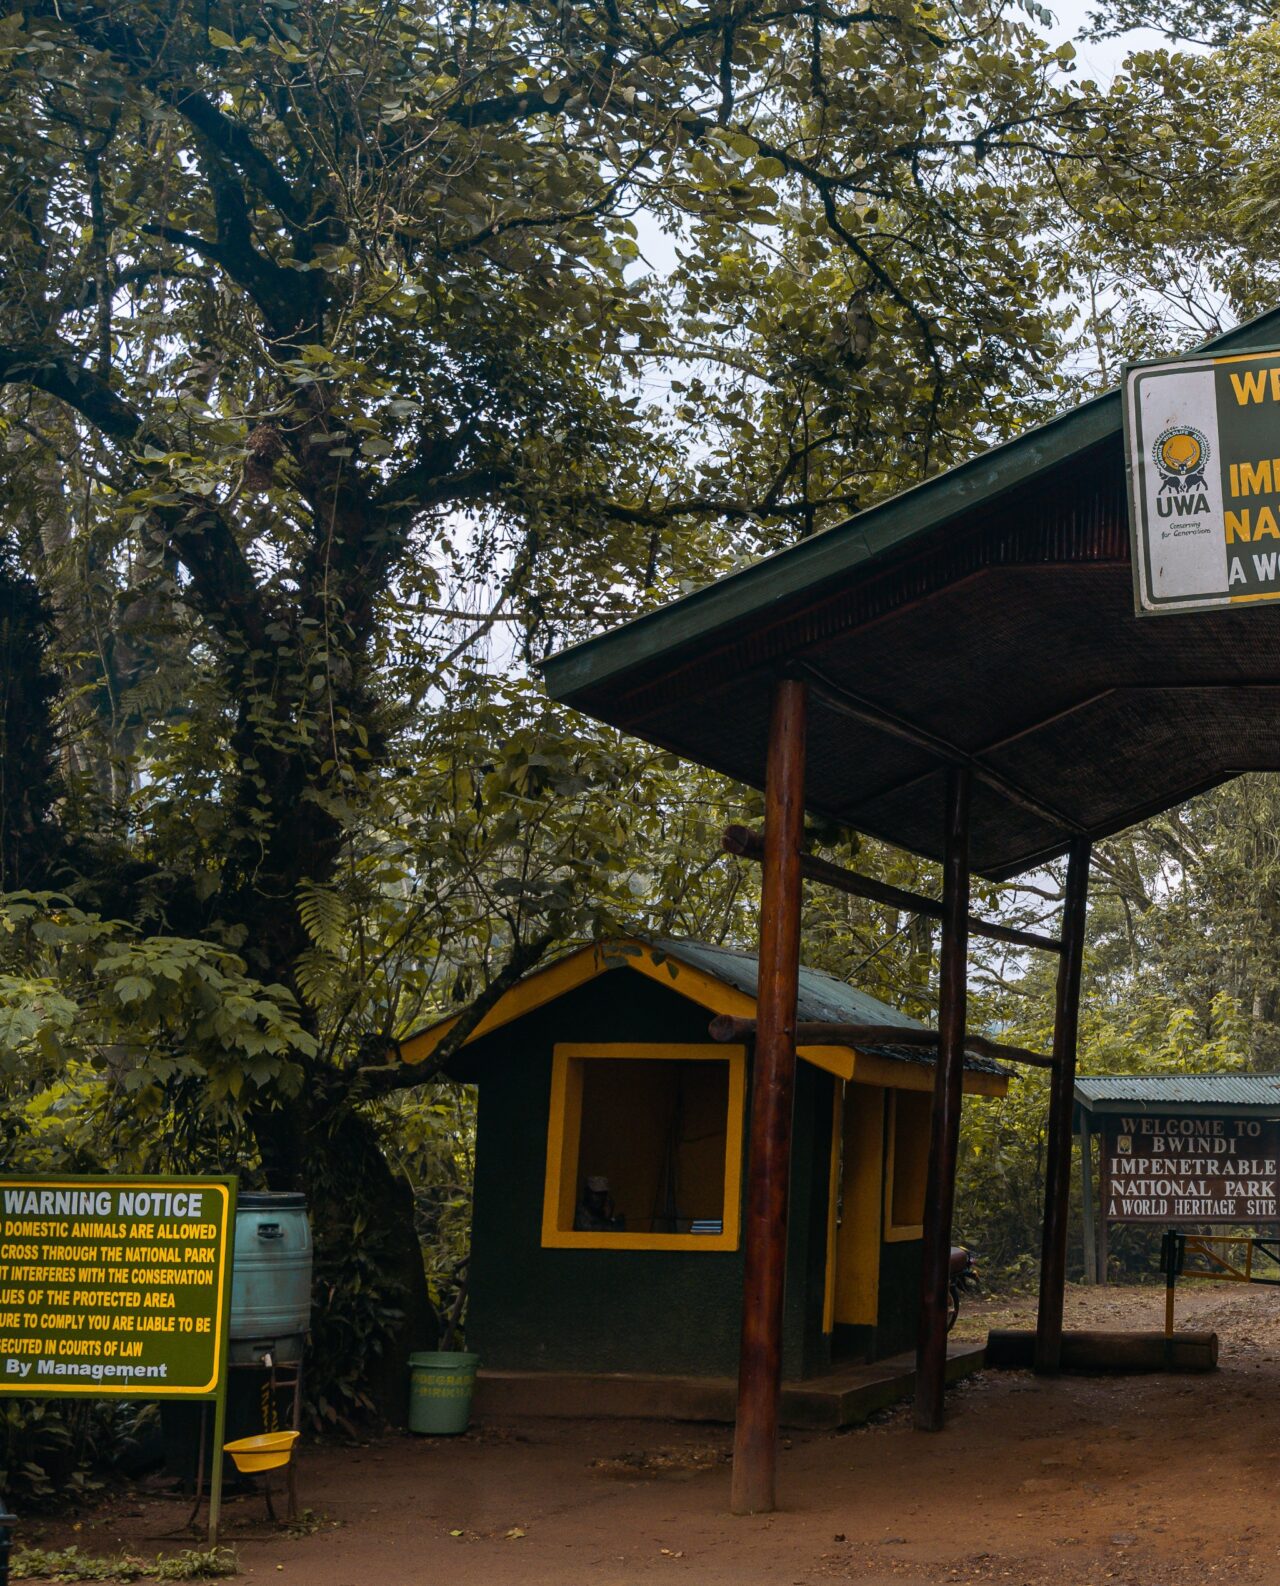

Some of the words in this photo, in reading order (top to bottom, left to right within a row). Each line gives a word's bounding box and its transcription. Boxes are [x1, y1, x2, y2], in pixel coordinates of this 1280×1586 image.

[1156, 493, 1211, 518] UWA
[1161, 531, 1171, 540] for
[1173, 528, 1211, 537] Generations
[1228, 556, 1248, 585] A
[1120, 1117, 1225, 1136] WELCOME
[1233, 1120, 1262, 1137] TO
[1152, 1136, 1237, 1154] BWINDI
[1110, 1158, 1277, 1176] IMPENETRABLE
[1110, 1179, 1212, 1197] NATIONAL
[1224, 1180, 1276, 1197] PARK
[4, 1190, 112, 1216] WARNING
[118, 1192, 203, 1217] NOTICE
[1108, 1199, 1117, 1216] A
[1122, 1199, 1168, 1216] WORLD
[1174, 1199, 1236, 1216] HERITAGE
[1246, 1199, 1277, 1216] SITE
[5, 1221, 69, 1238] DOMESTIC
[71, 1222, 127, 1239] ANIMALS
[129, 1223, 155, 1239] ARE
[157, 1223, 217, 1240] ALLOWED
[1, 1244, 39, 1260] CROSS
[42, 1244, 98, 1262] THROUGH
[101, 1246, 123, 1262] THE
[125, 1246, 182, 1263] NATIONAL
[184, 1247, 216, 1263] PARK
[11, 1265, 76, 1282] INTERFERES
[78, 1267, 106, 1283] WITH
[108, 1268, 130, 1284] THE
[131, 1268, 214, 1285] CONSERVATION
[28, 1289, 44, 1305] OF
[47, 1290, 71, 1306] THE
[73, 1291, 142, 1307] PROTECTED
[143, 1292, 176, 1308] AREA
[23, 1313, 38, 1329] TO
[40, 1313, 86, 1330] COMPLY
[88, 1314, 111, 1330] YOU
[112, 1315, 135, 1331] ARE
[136, 1316, 176, 1332] LIABLE
[178, 1317, 194, 1333] TO
[195, 1317, 212, 1333] BE
[45, 1339, 57, 1355] IN
[59, 1340, 102, 1356] COURTS
[103, 1341, 119, 1356] OF
[120, 1341, 144, 1357] LAW
[6, 1358, 32, 1378] By
[37, 1359, 168, 1380] Management
